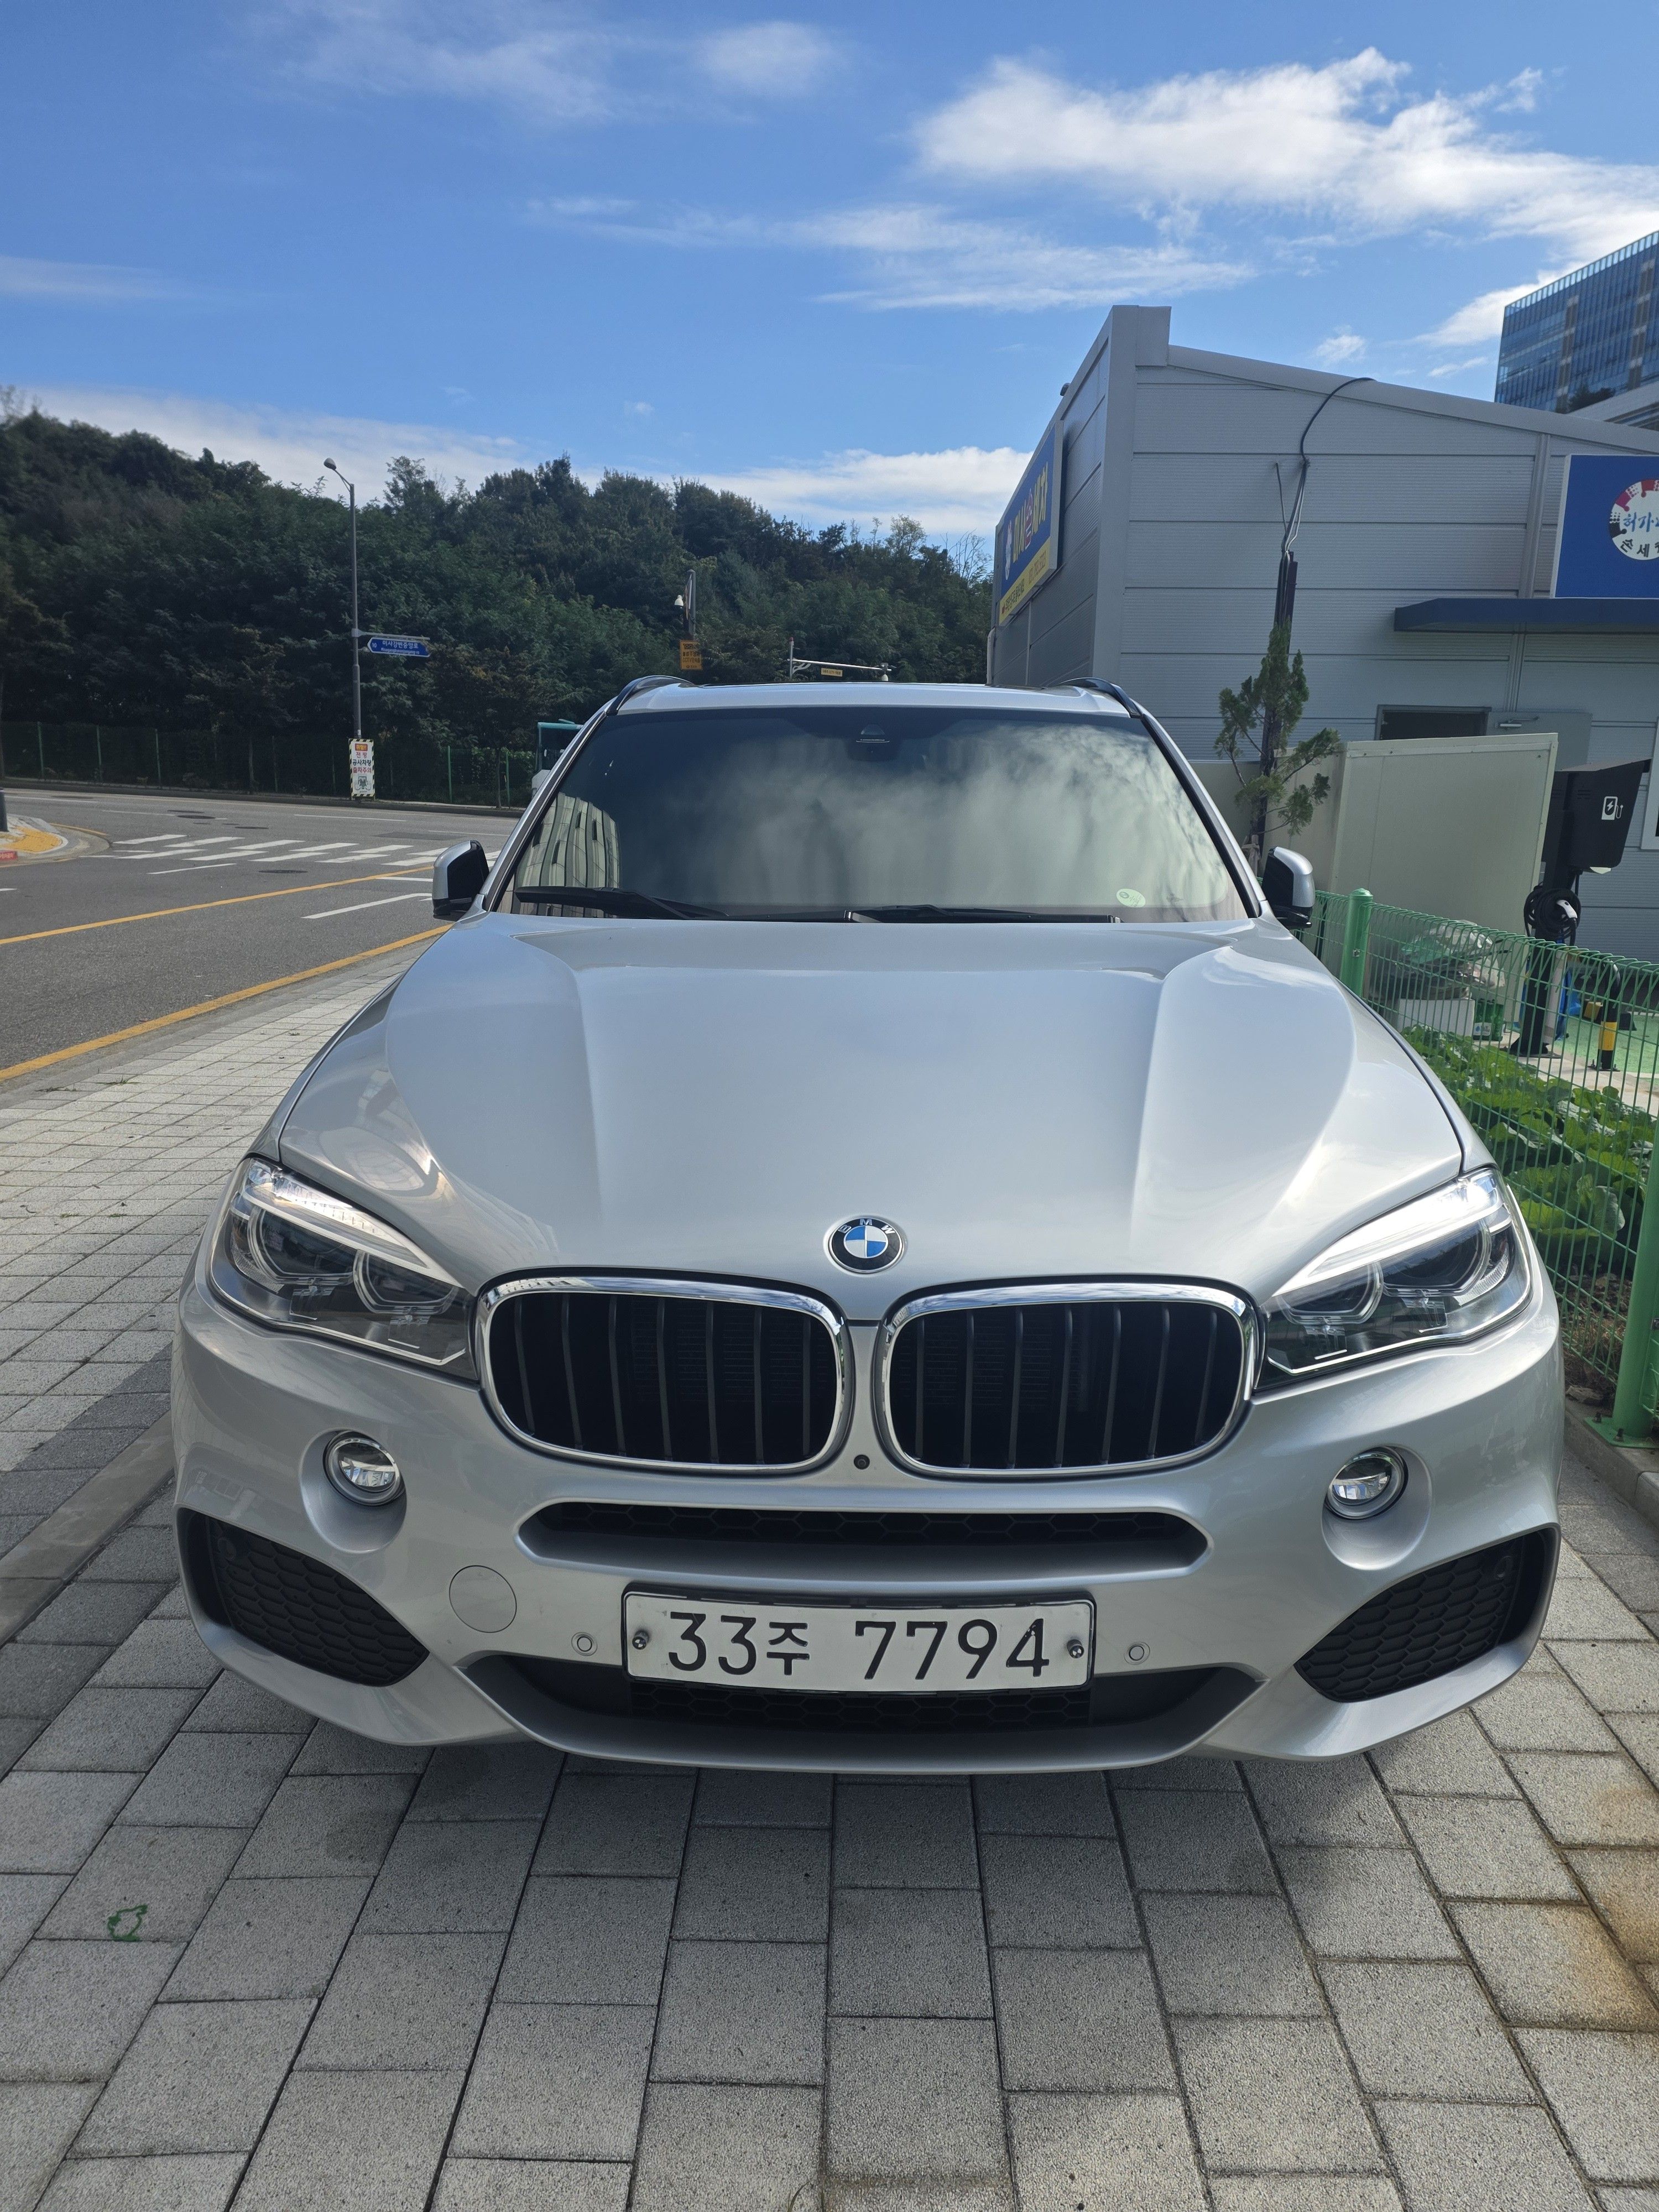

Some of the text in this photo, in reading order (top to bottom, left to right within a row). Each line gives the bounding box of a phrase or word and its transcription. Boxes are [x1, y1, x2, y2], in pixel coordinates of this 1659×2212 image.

[382, 640, 419, 649] 미사강변중앙로
[838, 1218, 895, 1234] BMW
[668, 1611, 1050, 1680] 33주 7794
